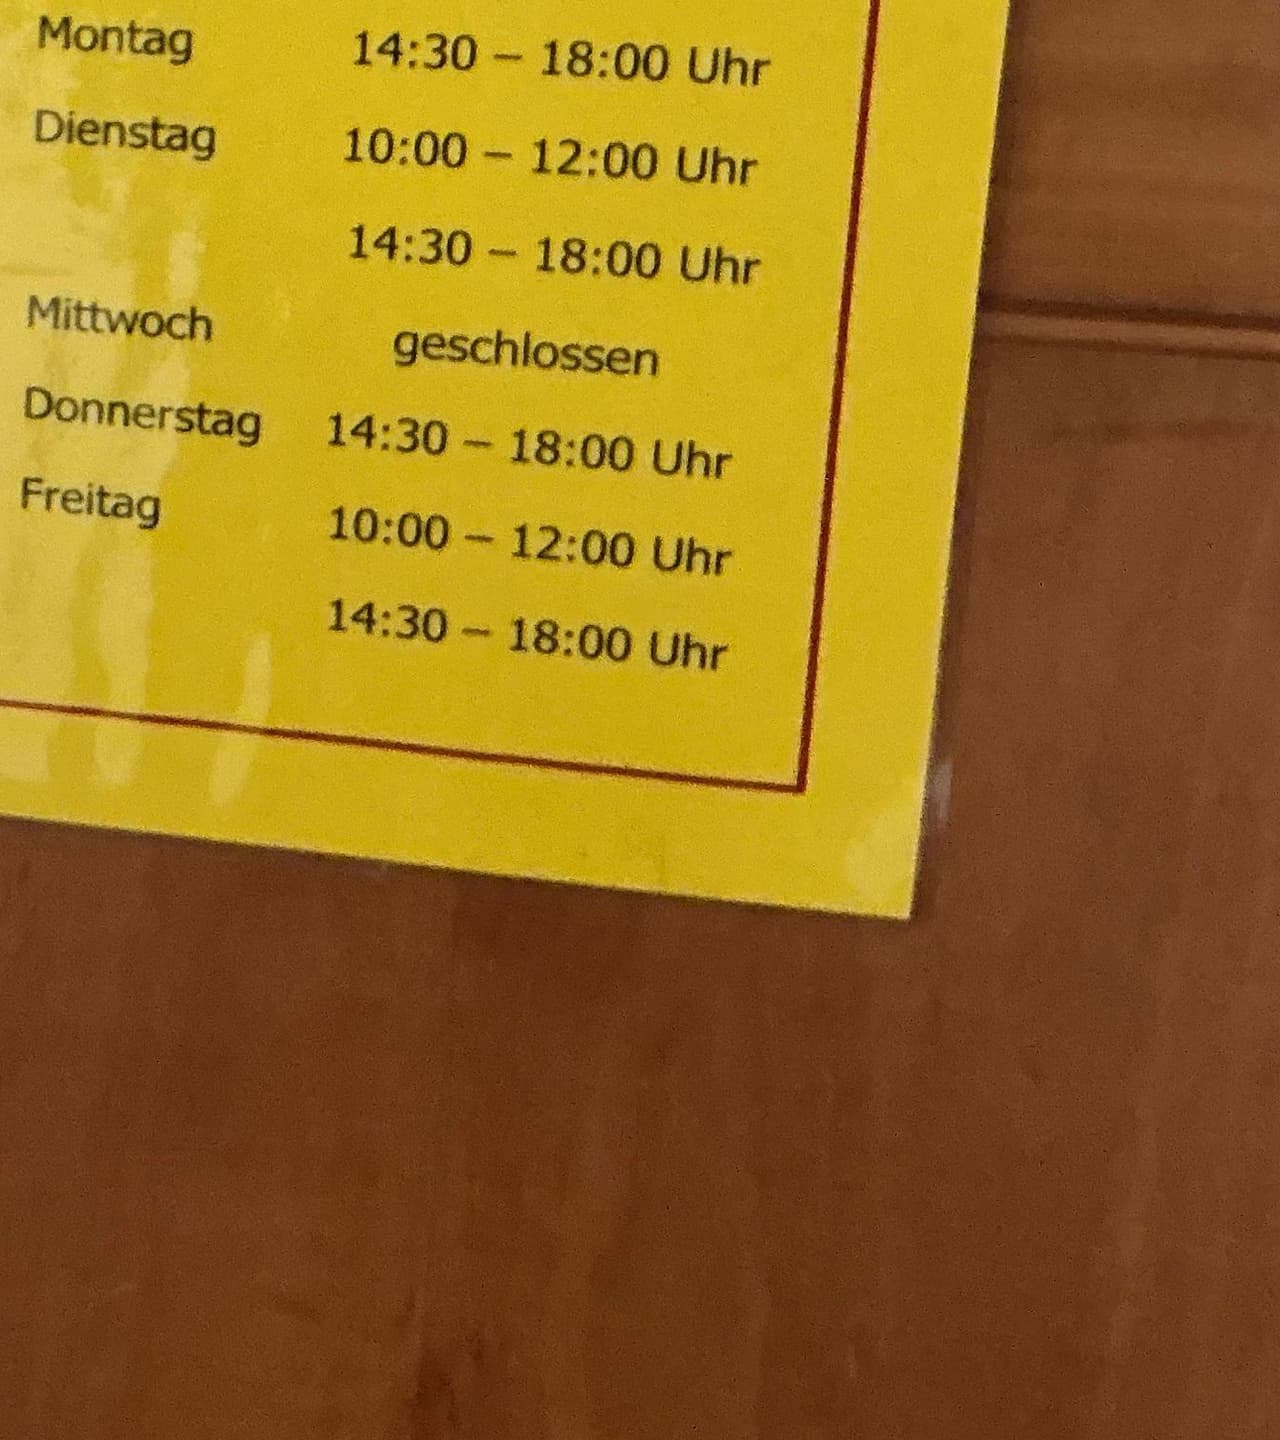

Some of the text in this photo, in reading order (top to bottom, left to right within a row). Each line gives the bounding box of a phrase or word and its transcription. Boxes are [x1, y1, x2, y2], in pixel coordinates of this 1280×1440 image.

[37, 14, 194, 67] Montag
[353, 29, 479, 72] 14:30
[541, 39, 671, 83] 18:00
[688, 46, 772, 87] Uhr
[34, 108, 217, 163] Dienstag
[343, 127, 469, 170] 10:00
[531, 137, 659, 182] 12:00
[675, 145, 759, 186] Uhr
[349, 222, 474, 268] 14:30
[536, 236, 663, 280] 18:00
[679, 244, 762, 286] Uhr
[27, 294, 660, 377] Mittwoch geschlossen
[23, 385, 262, 447] Donnerstag
[327, 411, 449, 457] 14:30
[510, 428, 636, 473] 18:00
[652, 438, 734, 480] Uhr
[20, 476, 162, 532] Freitag
[329, 505, 451, 553] 10:00
[511, 523, 636, 570] 12:00
[652, 535, 733, 577] Uhr
[328, 597, 450, 644] 14:30
[509, 616, 633, 663] 18:00
[649, 630, 729, 672] Uhr
